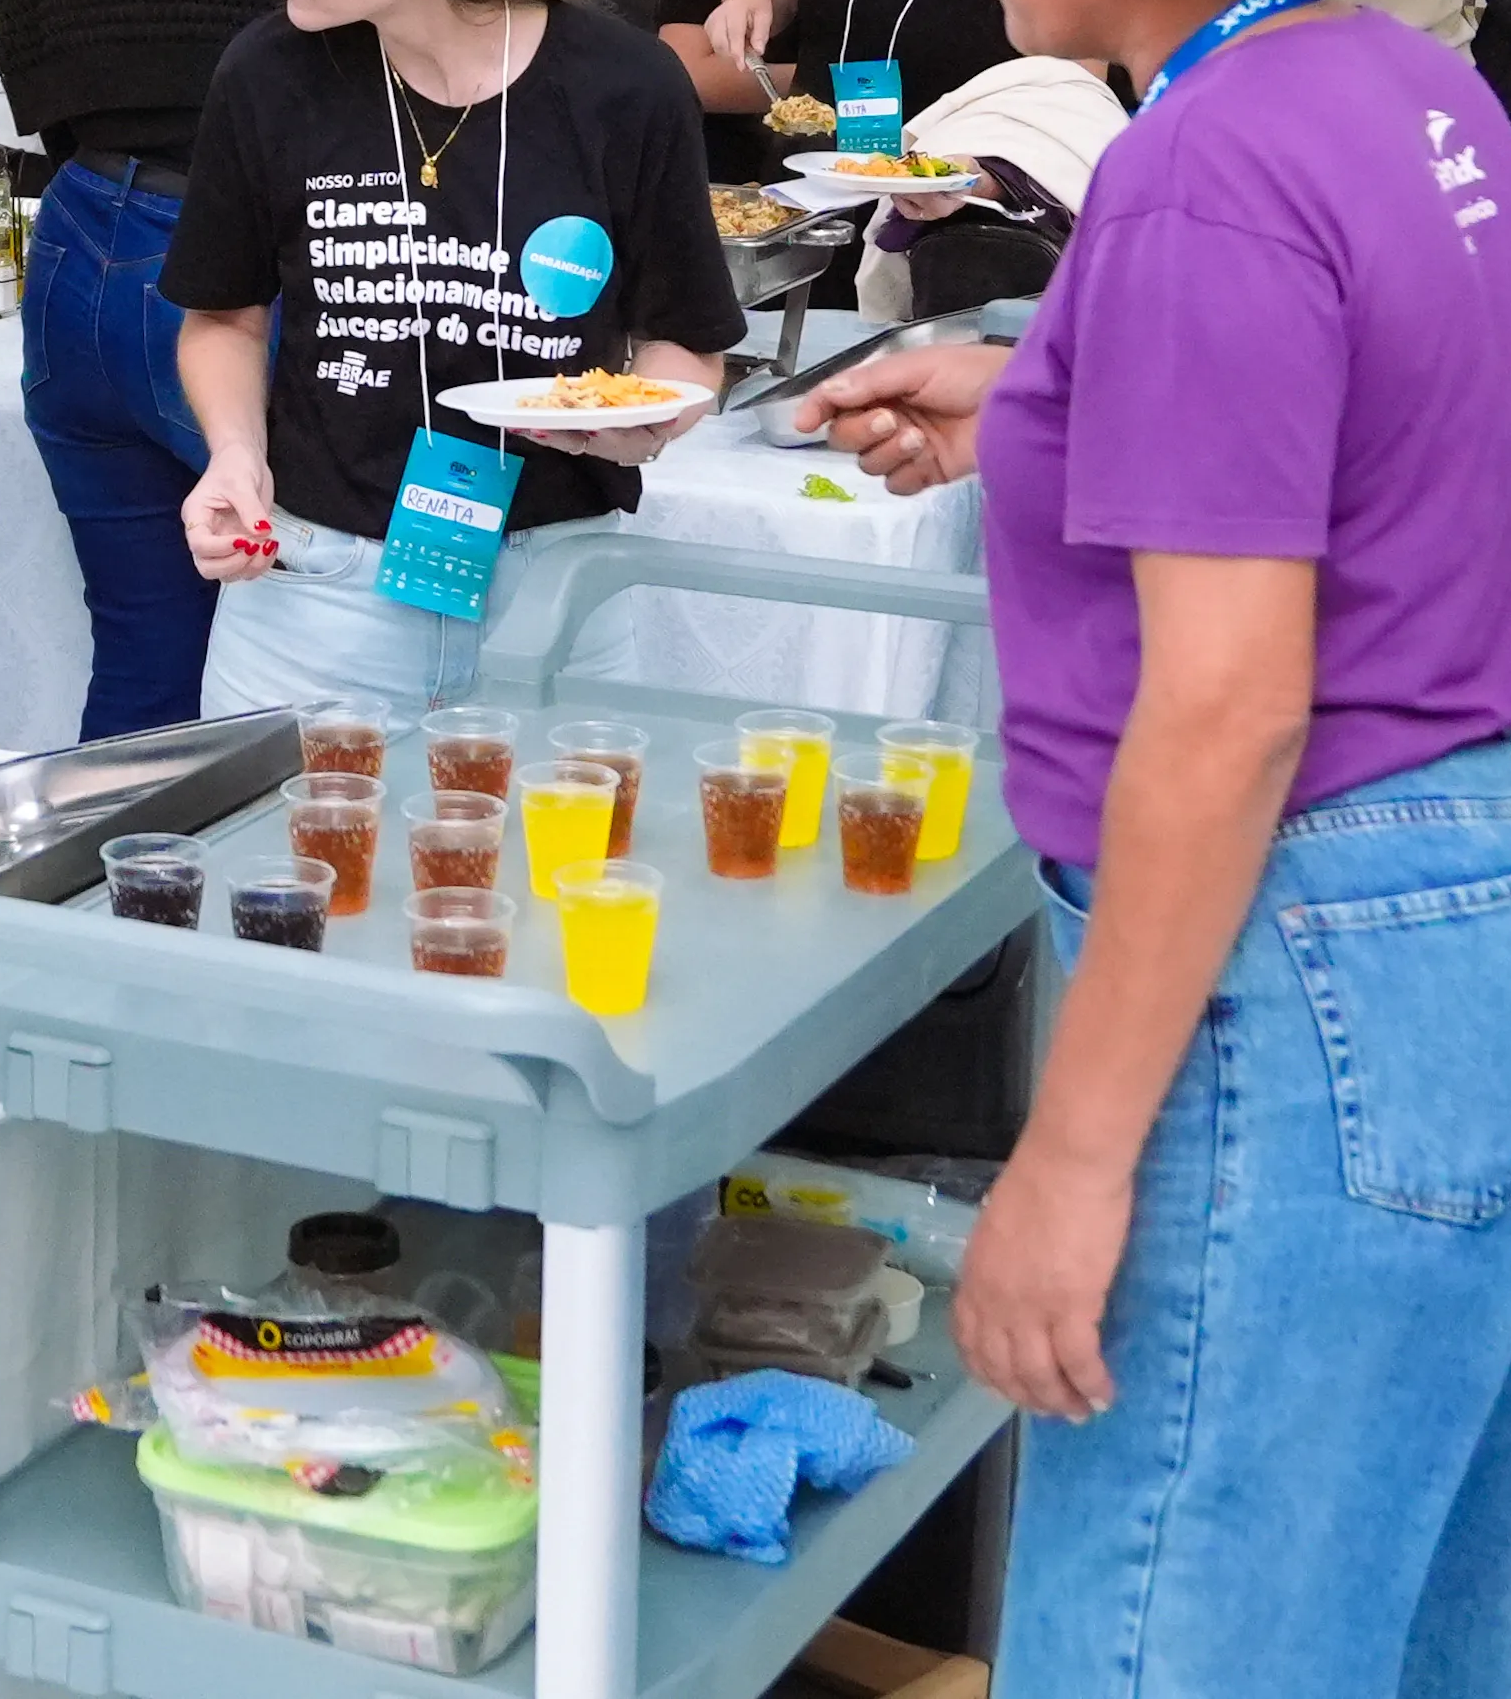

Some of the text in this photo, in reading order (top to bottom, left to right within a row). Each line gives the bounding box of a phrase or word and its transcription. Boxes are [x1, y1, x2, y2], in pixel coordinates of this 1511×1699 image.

[305, 173, 354, 191] NOSSO
[306, 199, 427, 229] Clareza
[309, 235, 510, 274] Simplicidade
[316, 312, 583, 360] Sucesso do Cliente
[316, 360, 392, 388] SEBRAE
[406, 487, 475, 524] RENATA
